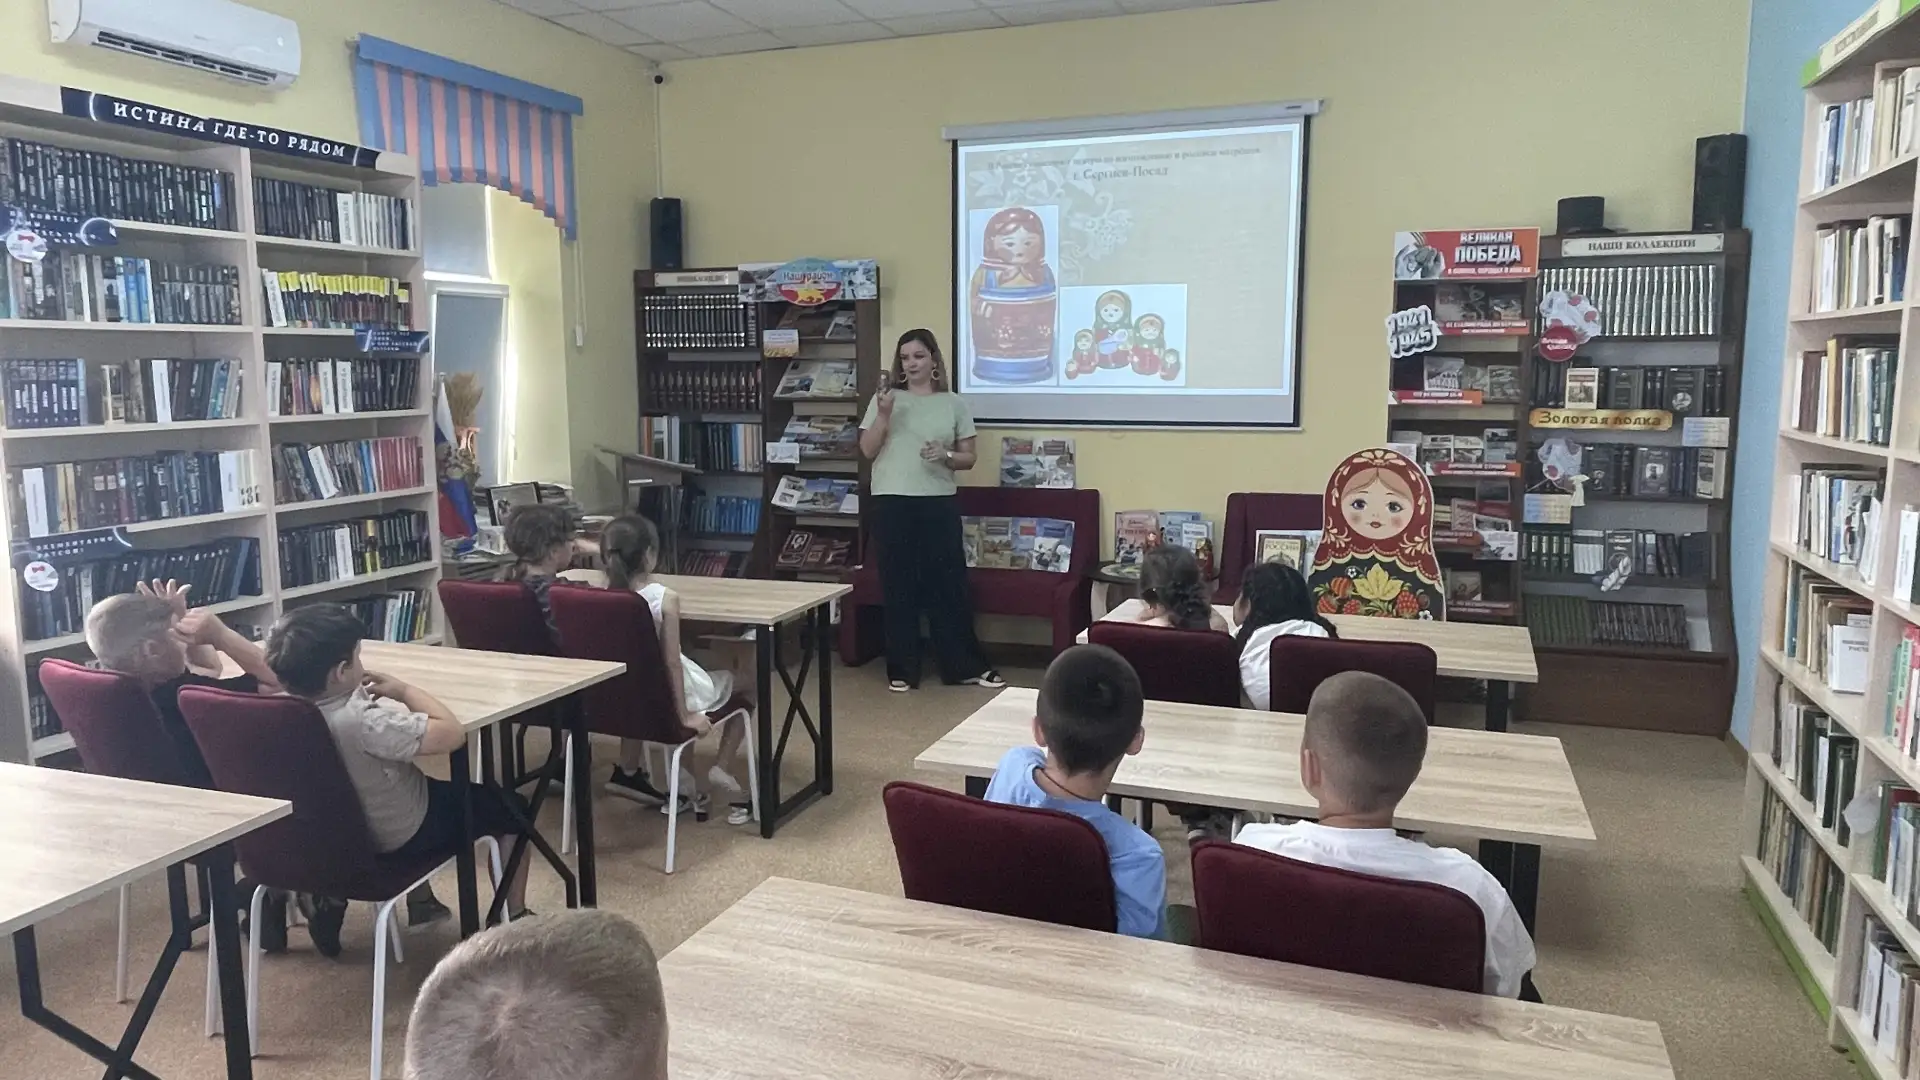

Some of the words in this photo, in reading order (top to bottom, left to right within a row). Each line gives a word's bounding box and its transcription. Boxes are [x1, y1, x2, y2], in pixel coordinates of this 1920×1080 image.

[113, 102, 205, 132] ИСТИНА
[213, 122, 279, 145] ГДЕ-ТО
[288, 136, 344, 157] РЯДОМ
[1460, 231, 1513, 244] ВЕЛИКАЯ
[1588, 240, 1622, 251] НАШИ
[1626, 238, 1697, 250] КОЛЛЕКЦИИ
[1454, 244, 1521, 265] ПОБЕДА
[1388, 309, 1429, 335] 1941
[1390, 328, 1432, 355] 1945
[1539, 410, 1609, 425] Золотая
[1613, 414, 1662, 426] полка
